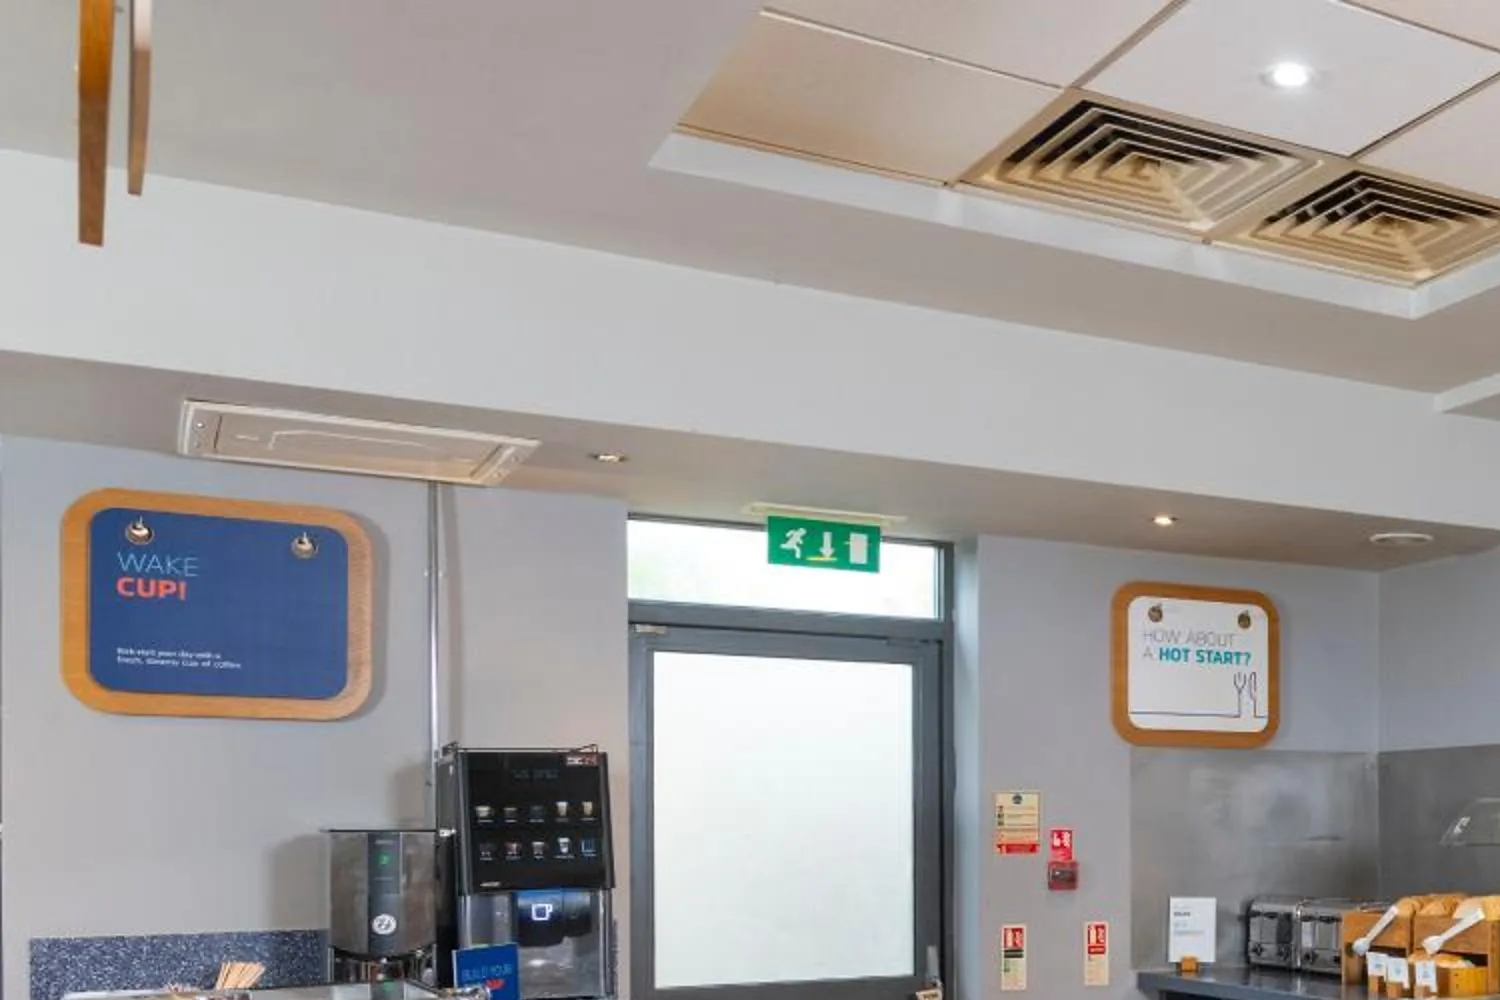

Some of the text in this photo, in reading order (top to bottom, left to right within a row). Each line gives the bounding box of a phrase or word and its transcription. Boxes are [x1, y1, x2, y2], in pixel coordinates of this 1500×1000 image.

[117, 551, 200, 578] WAKE
[116, 577, 187, 601] CUP!
[1143, 629, 1236, 648] HOW ABOUT
[1143, 647, 1252, 666] A HOT START?
